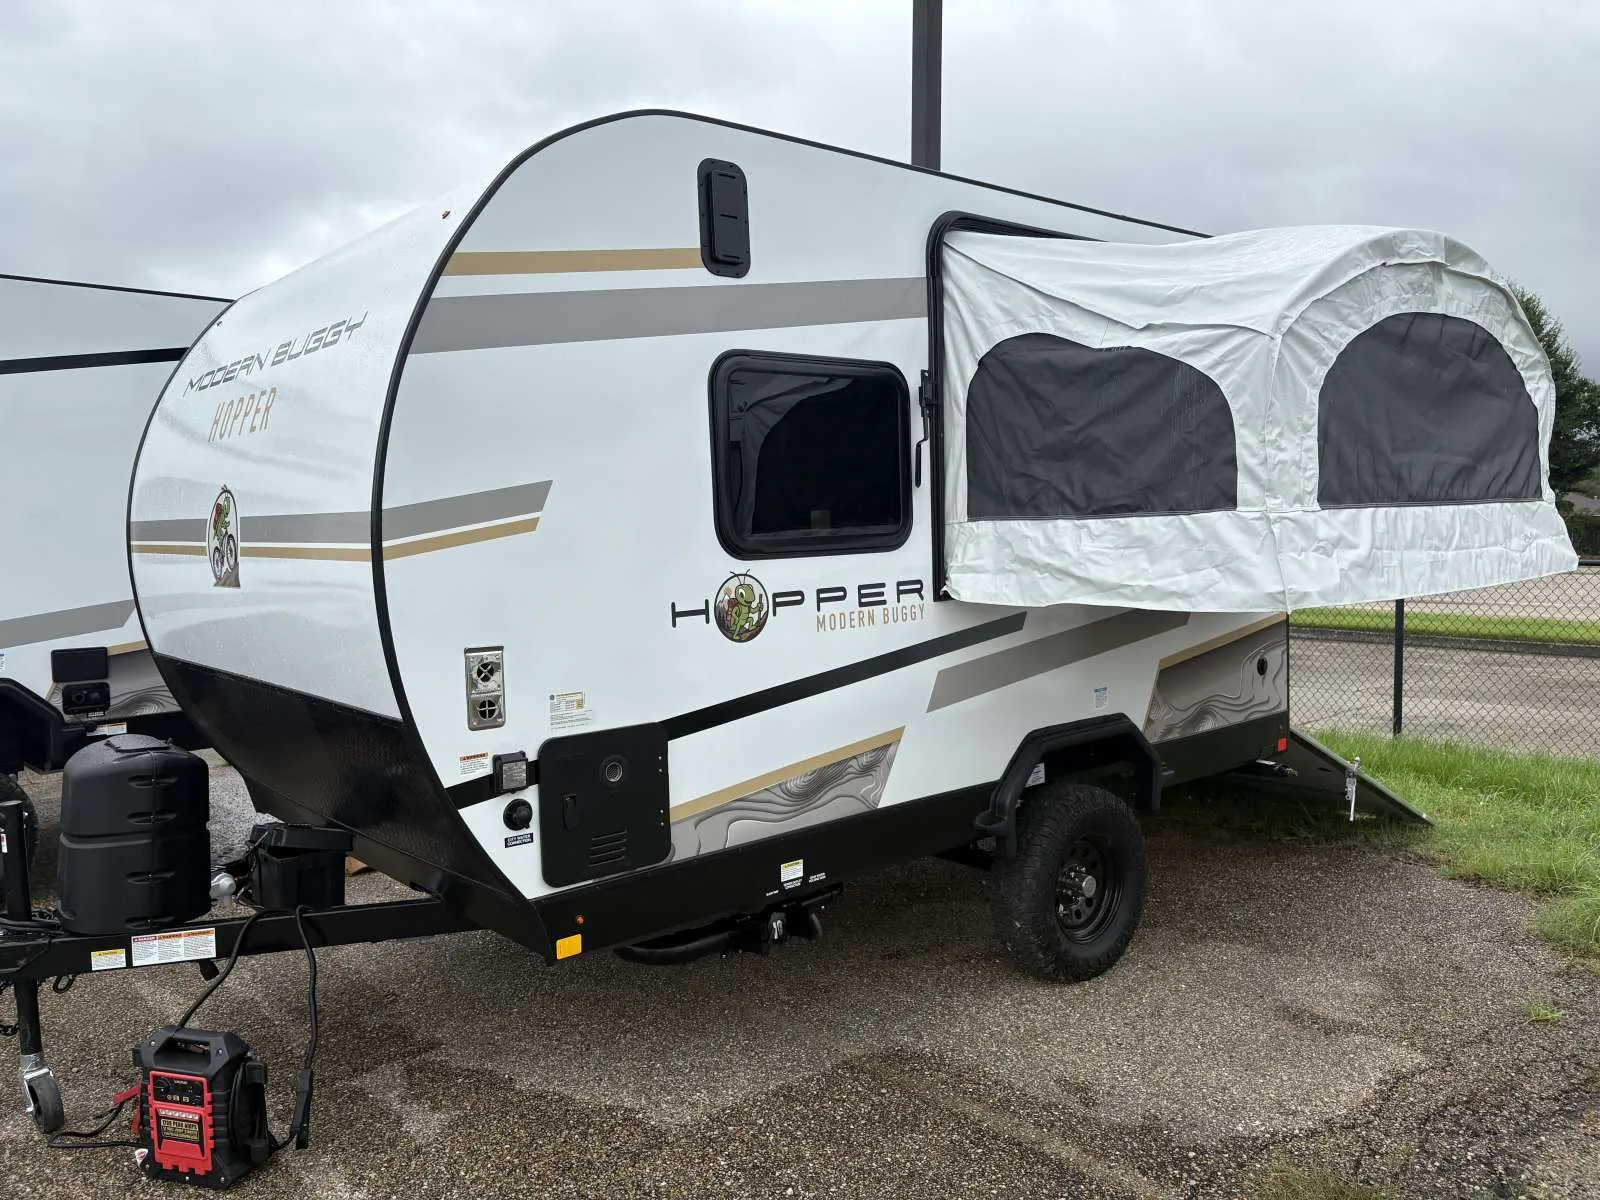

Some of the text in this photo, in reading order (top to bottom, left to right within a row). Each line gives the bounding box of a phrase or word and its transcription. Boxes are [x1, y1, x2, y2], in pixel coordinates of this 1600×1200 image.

[183, 311, 368, 398] MODERN BUGGY
[208, 387, 277, 443] HOPPER
[816, 603, 926, 632] MODERN BUGGY
